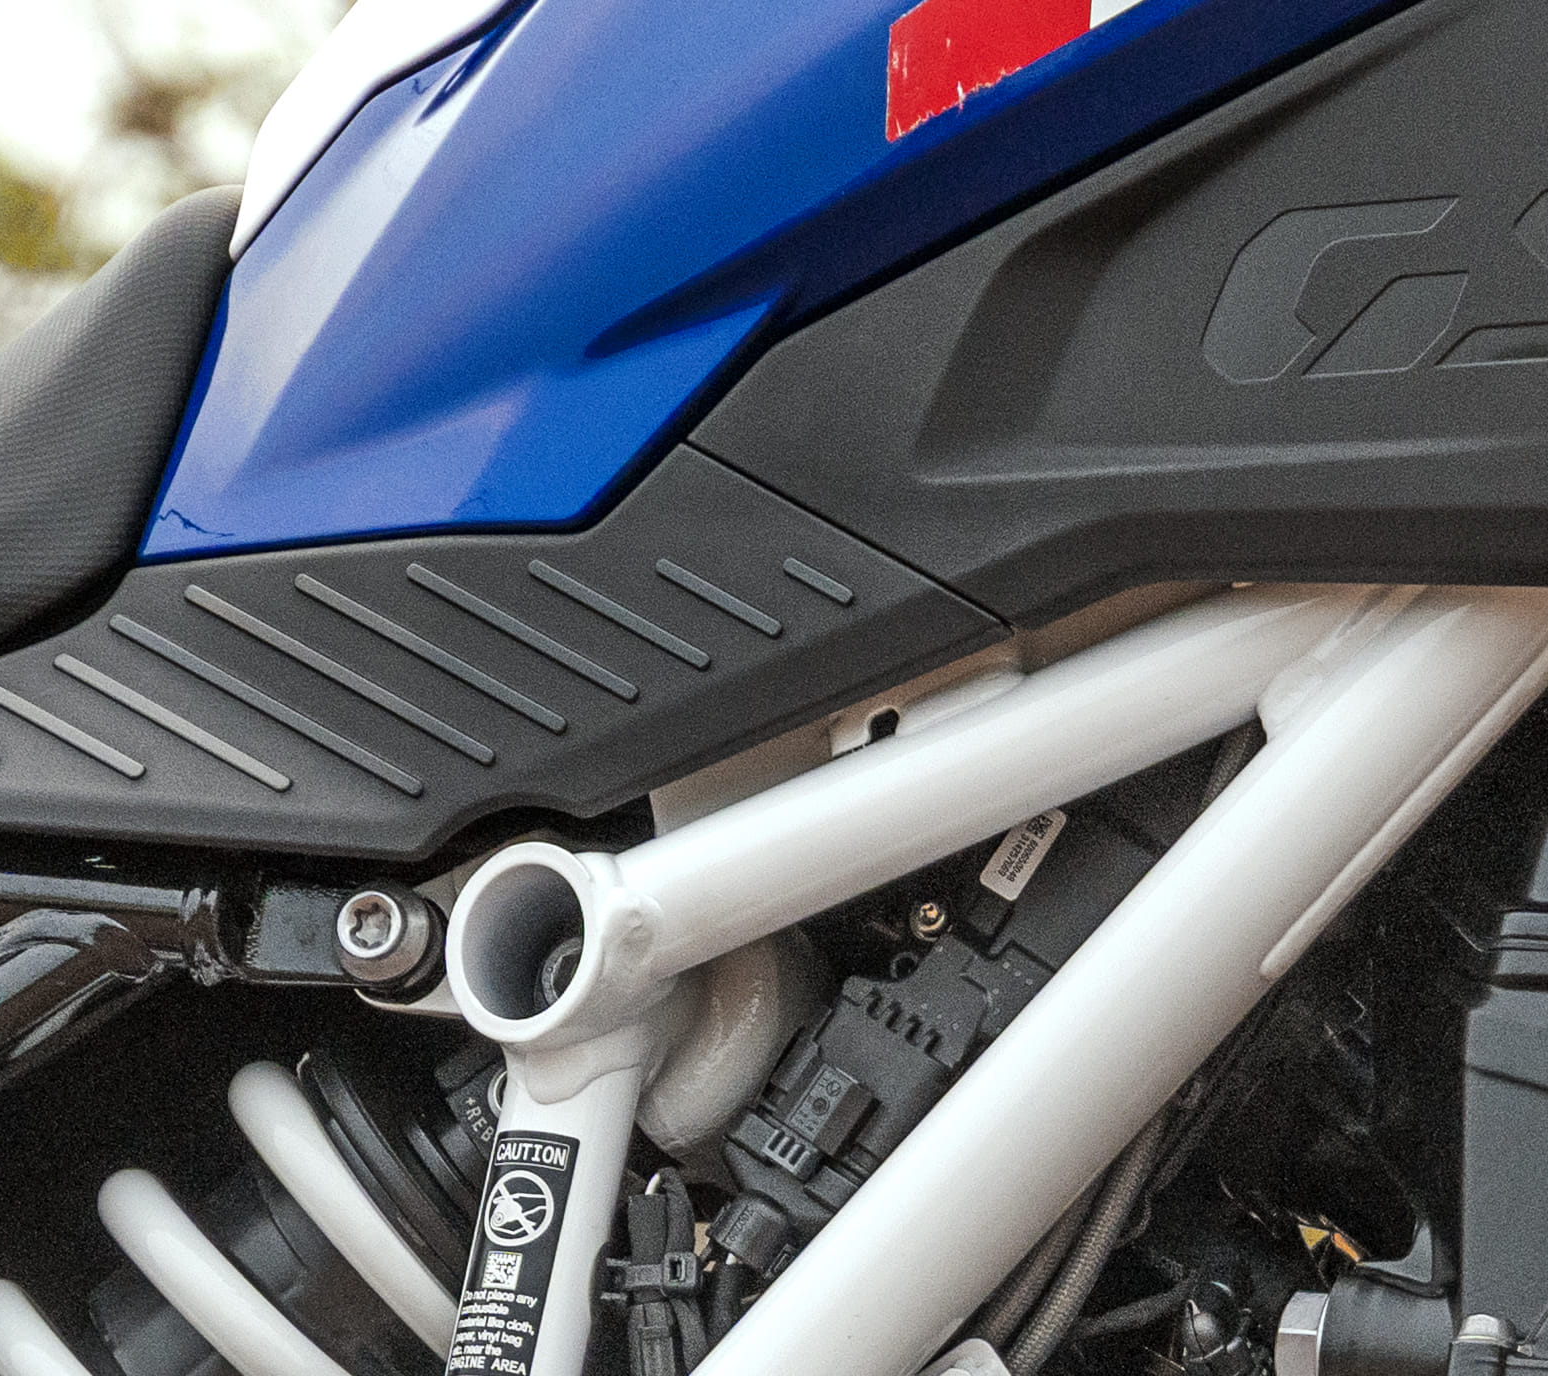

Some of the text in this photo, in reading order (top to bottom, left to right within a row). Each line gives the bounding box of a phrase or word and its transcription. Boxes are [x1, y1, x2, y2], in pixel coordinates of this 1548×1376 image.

[496, 1143, 567, 1168] CAUTION
[473, 1289, 487, 1300] not
[486, 1289, 515, 1302] place
[516, 1294, 538, 1308] any
[487, 1316, 505, 1328] like
[506, 1319, 535, 1336] cloth,
[477, 1329, 501, 1344] vinyl
[501, 1331, 523, 1348] bag
[463, 1345, 485, 1355] near
[485, 1344, 502, 1356] the
[449, 1356, 527, 1376] ENGINE AREA
